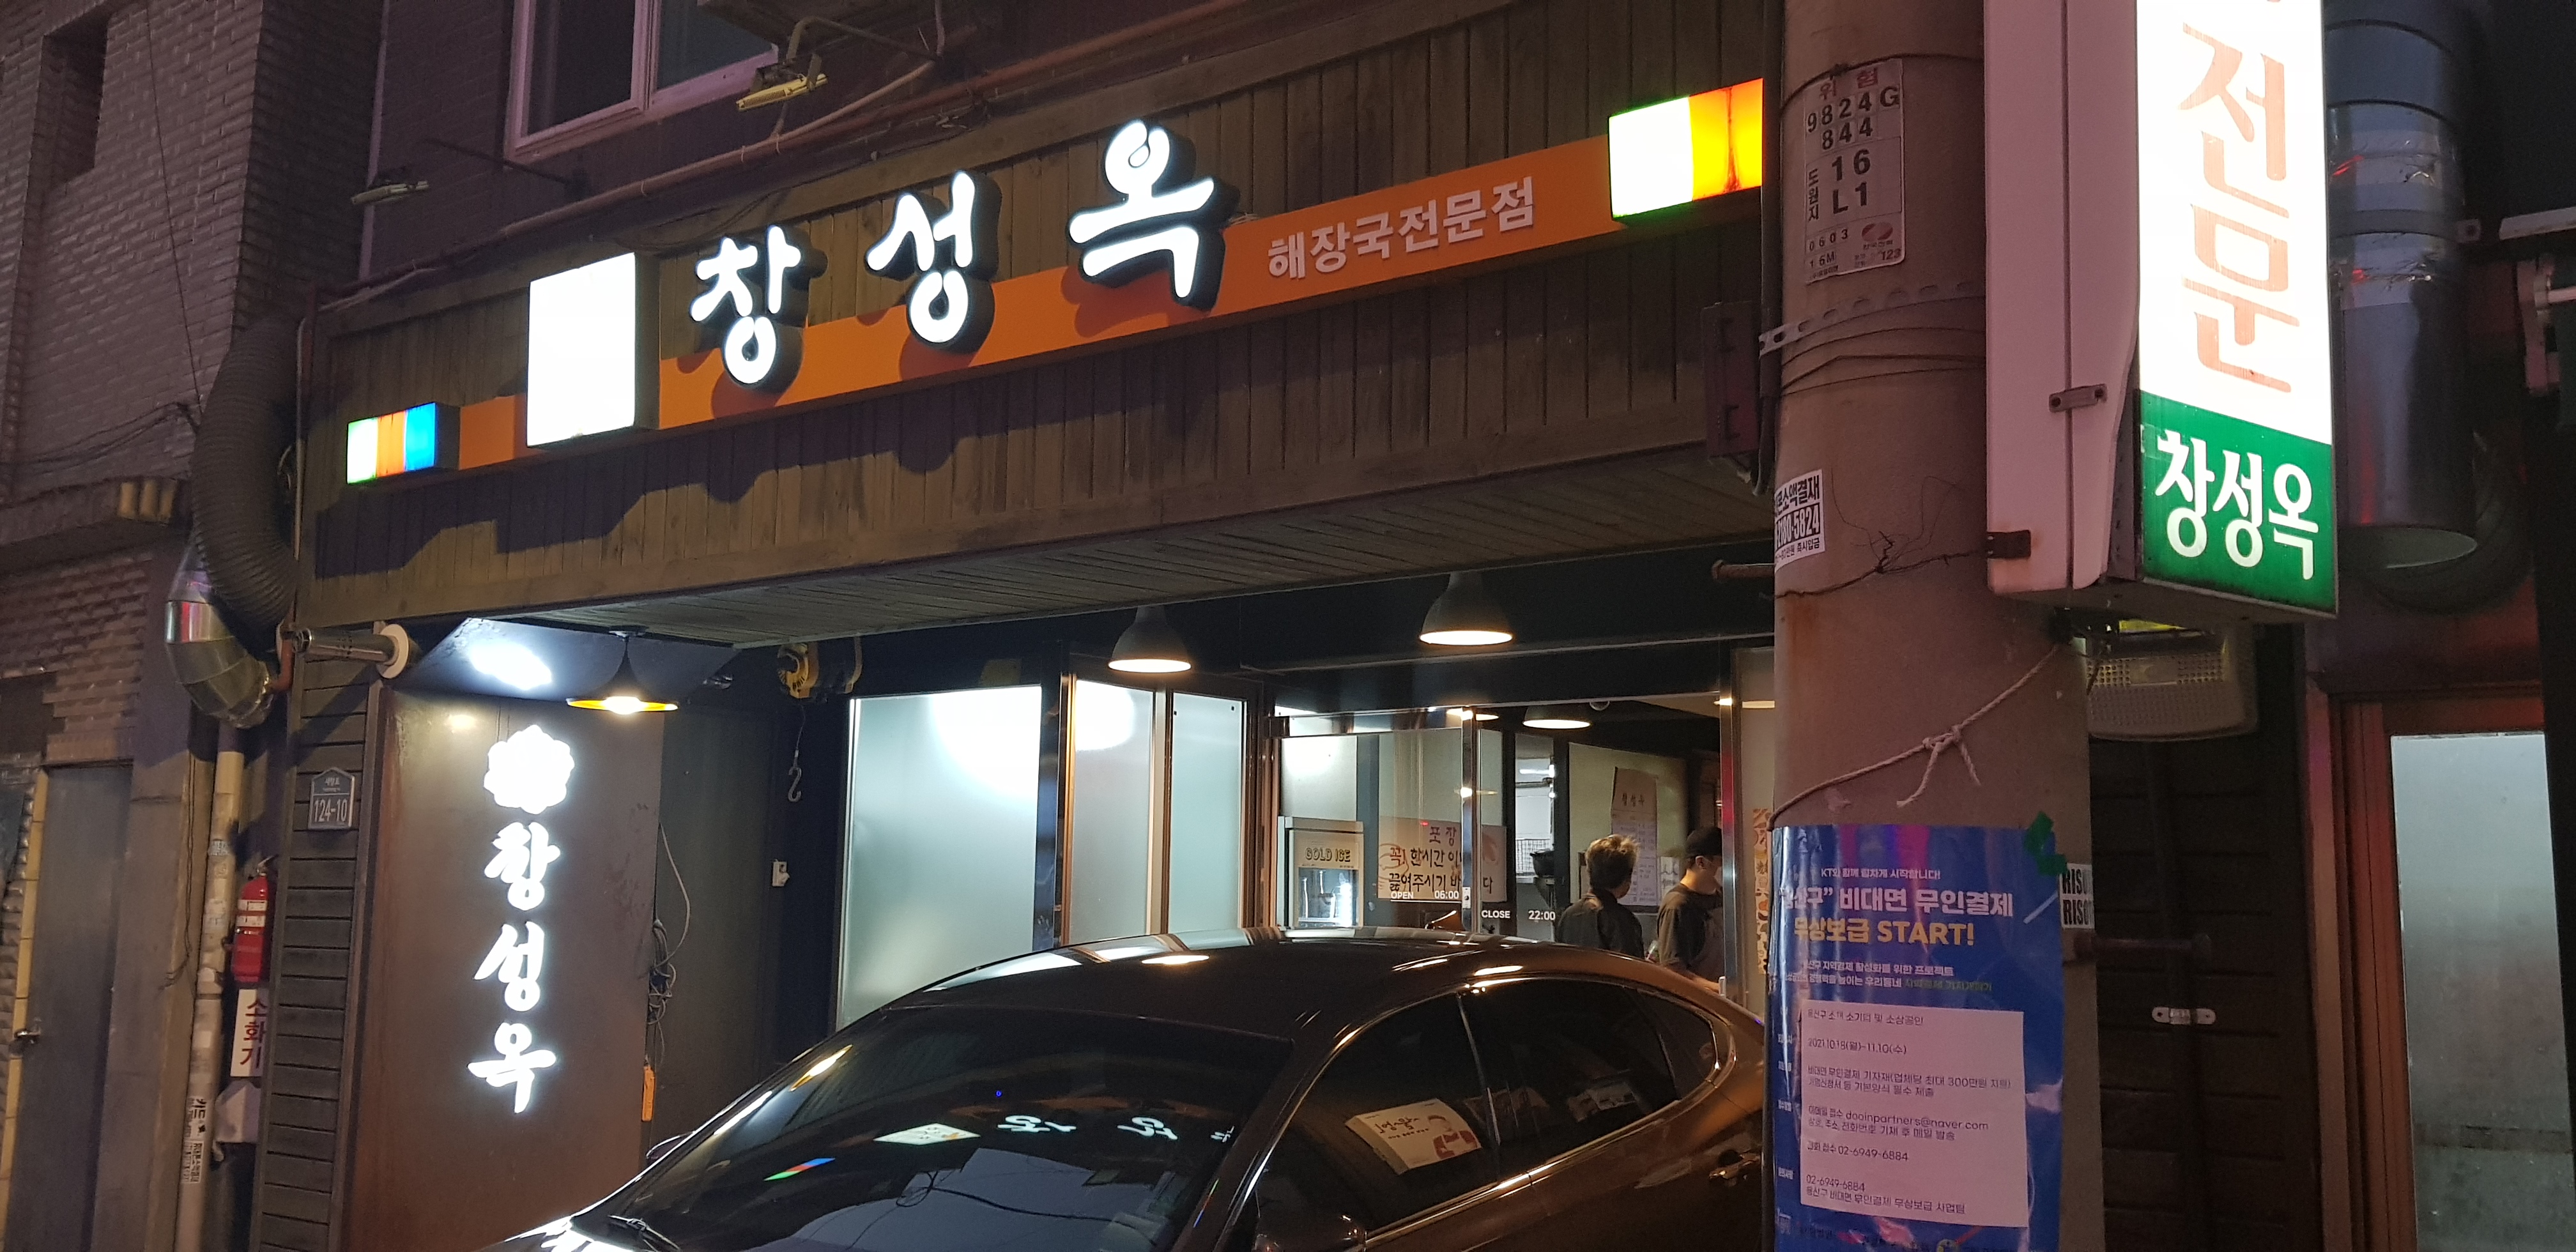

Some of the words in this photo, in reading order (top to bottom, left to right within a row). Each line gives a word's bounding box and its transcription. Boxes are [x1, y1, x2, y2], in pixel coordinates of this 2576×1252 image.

[1822, 117, 1874, 151] 844
[1268, 176, 1533, 279] 해장국전문점
[689, 118, 1216, 385] 창성옥
[2154, 429, 2319, 581] 창성옥
[314, 798, 348, 822] 124-10
[1305, 847, 1333, 862] GOLD
[1335, 848, 1351, 862] ICE
[1391, 891, 1414, 900] OPEN
[1434, 890, 1459, 899] 06:00
[1839, 887, 1908, 912] 비대면
[1916, 889, 2014, 917] 무인결제
[1482, 910, 1510, 919] CLOSE
[1528, 910, 1556, 920] 22:00
[1794, 917, 1869, 944] 무상보급
[1877, 920, 1975, 946] START!
[468, 821, 561, 1113] 창성옥
[1886, 1014, 1924, 1026] 소상공인
[240, 998, 268, 1069] 소화기
[1828, 1067, 1860, 1080] 무인결제
[1925, 1075, 1945, 1086] 최대
[1947, 1076, 1987, 1088] 300만원
[1845, 1110, 1989, 1131] dooinpartners@naver.com
[1880, 1125, 1899, 1136] 기재
[1913, 1127, 1933, 1139] 메일
[1837, 1145, 1908, 1162] 02-6949-6884
[1806, 1174, 1866, 1193] 02-6949-6884
[1829, 1189, 1852, 1203] 비대면
[1854, 1193, 1891, 1207] 무인결제
[1894, 1198, 1933, 1212] 무상보급
